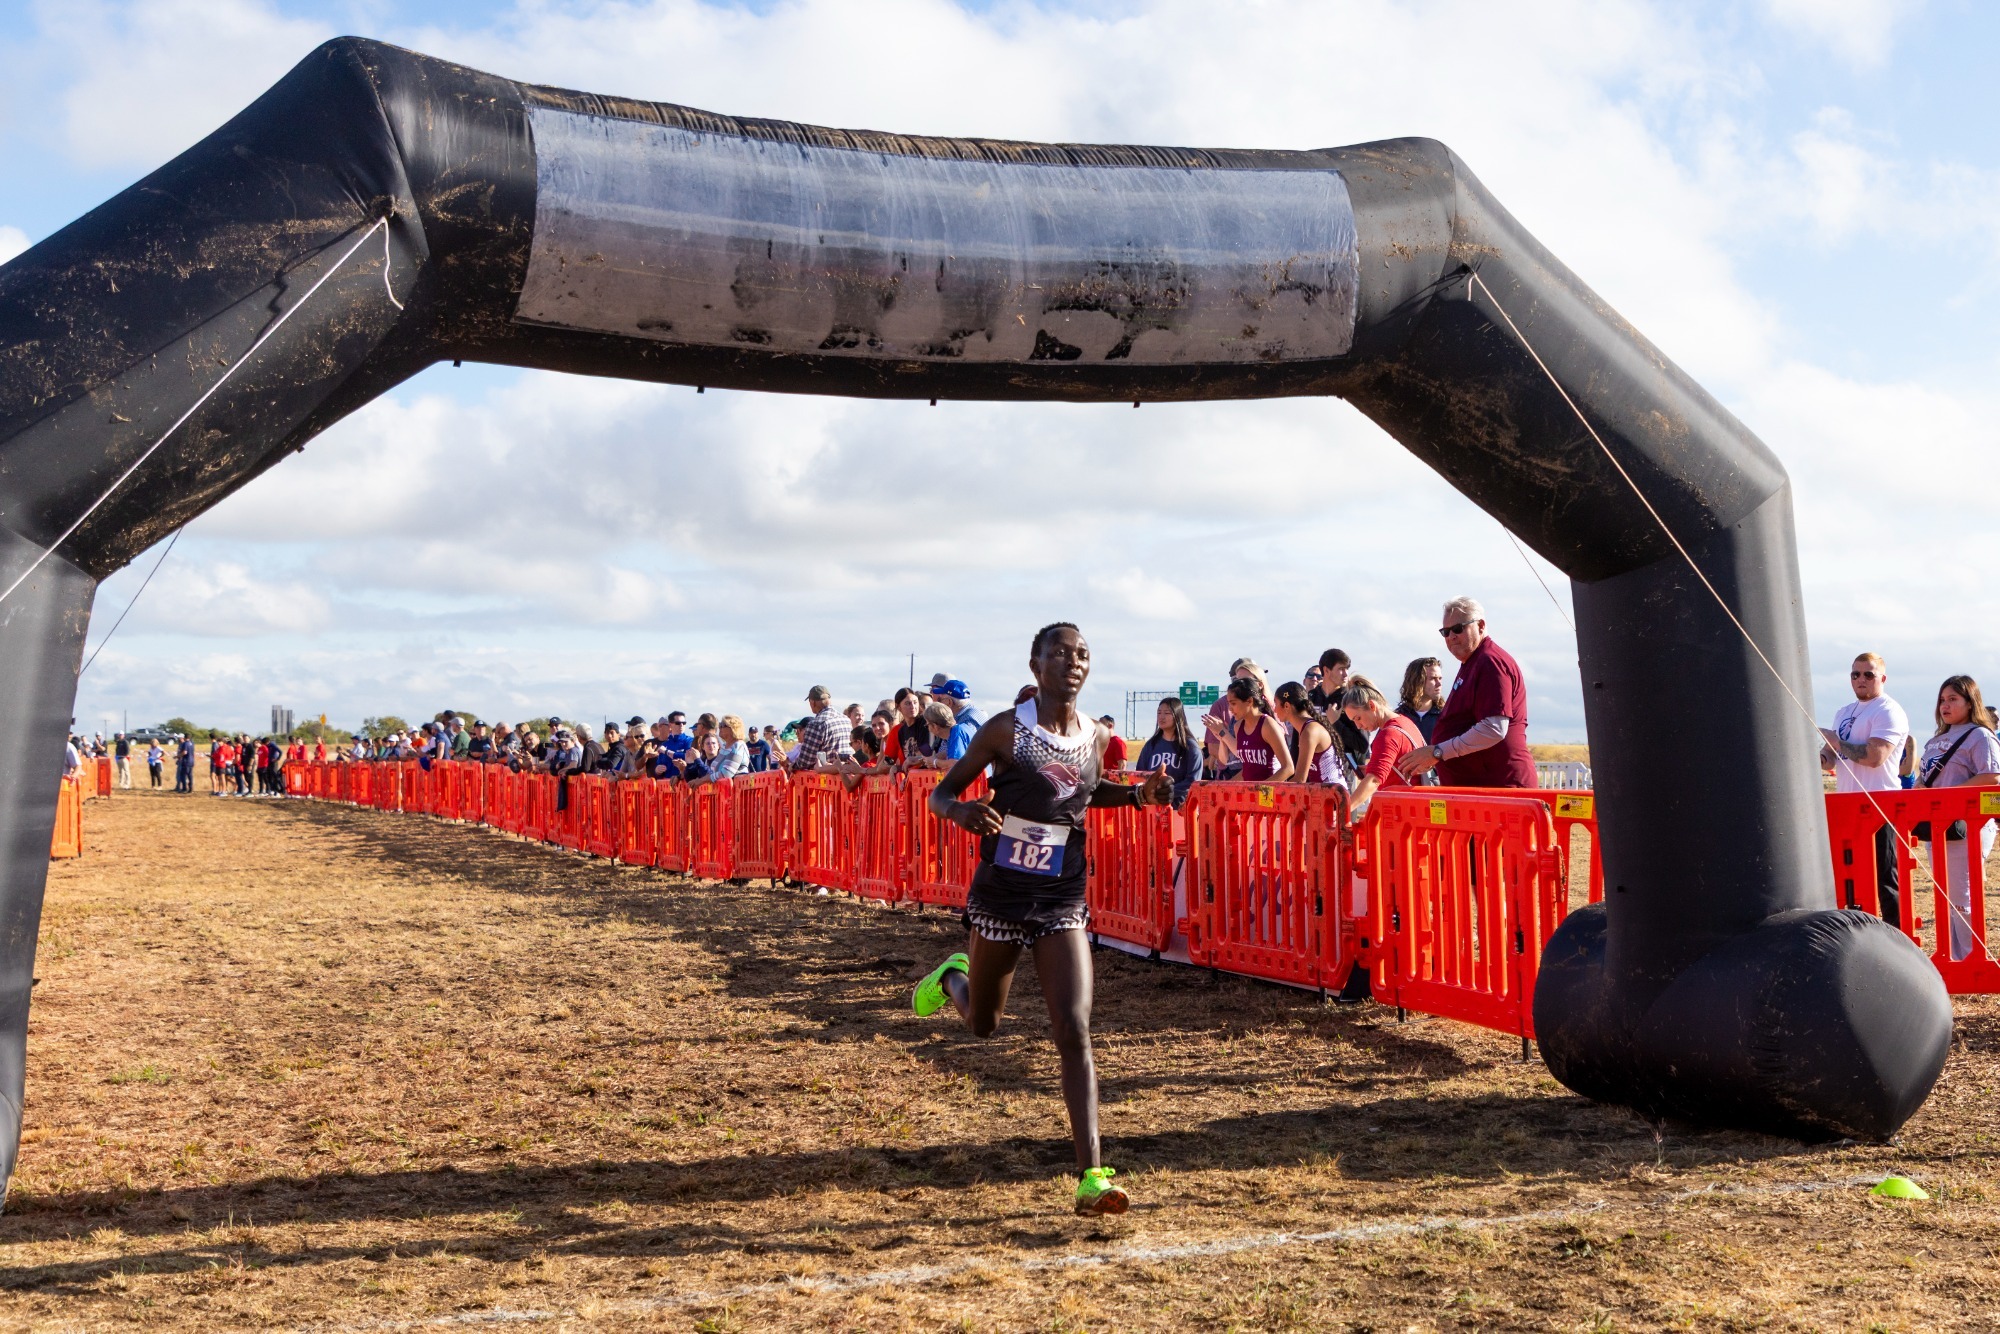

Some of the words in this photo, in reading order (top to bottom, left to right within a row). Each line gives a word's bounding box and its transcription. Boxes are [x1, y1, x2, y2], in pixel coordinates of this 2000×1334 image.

[1150, 752, 1183, 769] DBU
[1244, 748, 1267, 766] TEXAS
[1009, 840, 1053, 870] 182
